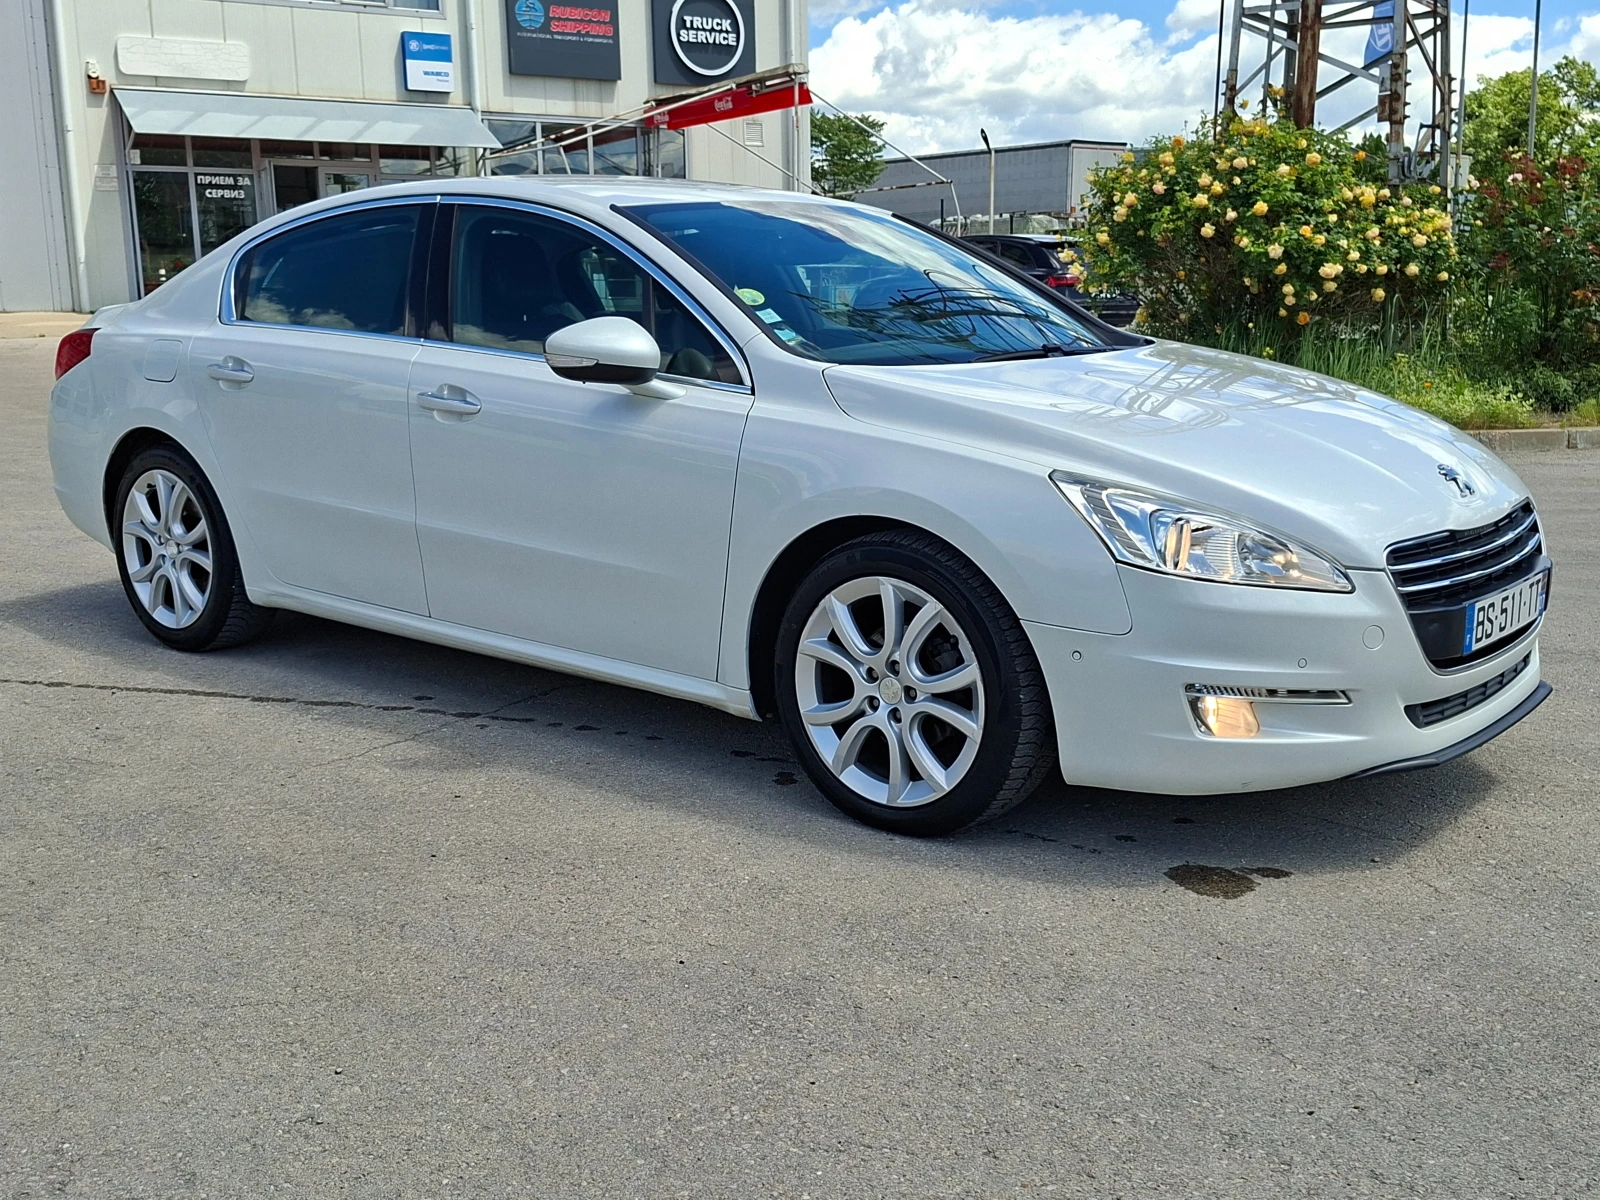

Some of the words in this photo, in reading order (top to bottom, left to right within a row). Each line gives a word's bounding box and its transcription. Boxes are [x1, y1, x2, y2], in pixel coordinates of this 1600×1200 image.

[549, 5, 610, 22] RUBICON
[550, 19, 613, 36] SHIPPING
[683, 15, 732, 32] TRUCK
[679, 29, 737, 46] SERVICE
[197, 175, 234, 185] ПРИЕМ
[236, 176, 252, 186] ЗА
[205, 189, 245, 199] СЕРВИЗ
